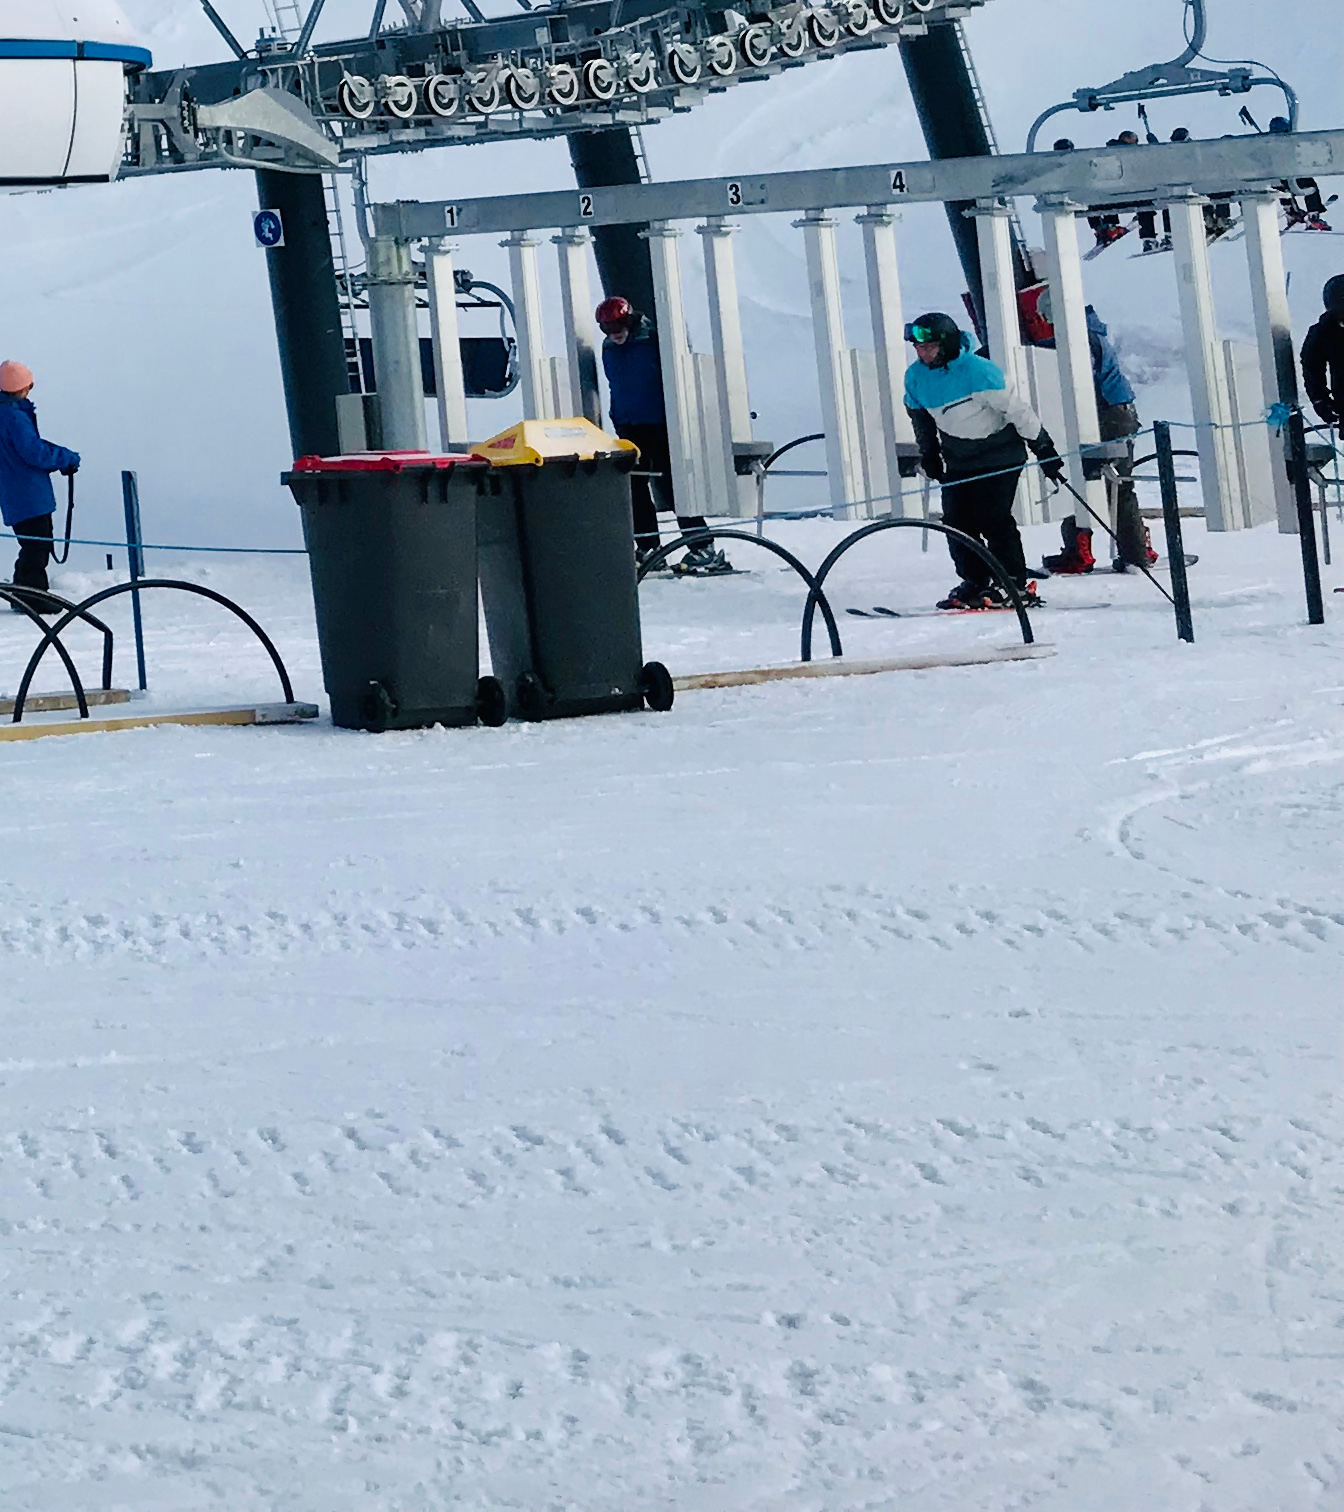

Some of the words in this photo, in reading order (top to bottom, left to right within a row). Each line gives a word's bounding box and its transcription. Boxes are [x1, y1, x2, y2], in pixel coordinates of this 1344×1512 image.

[892, 171, 906, 193] 4
[728, 183, 741, 205] 3
[581, 195, 593, 216] 2
[446, 206, 455, 227] 1
